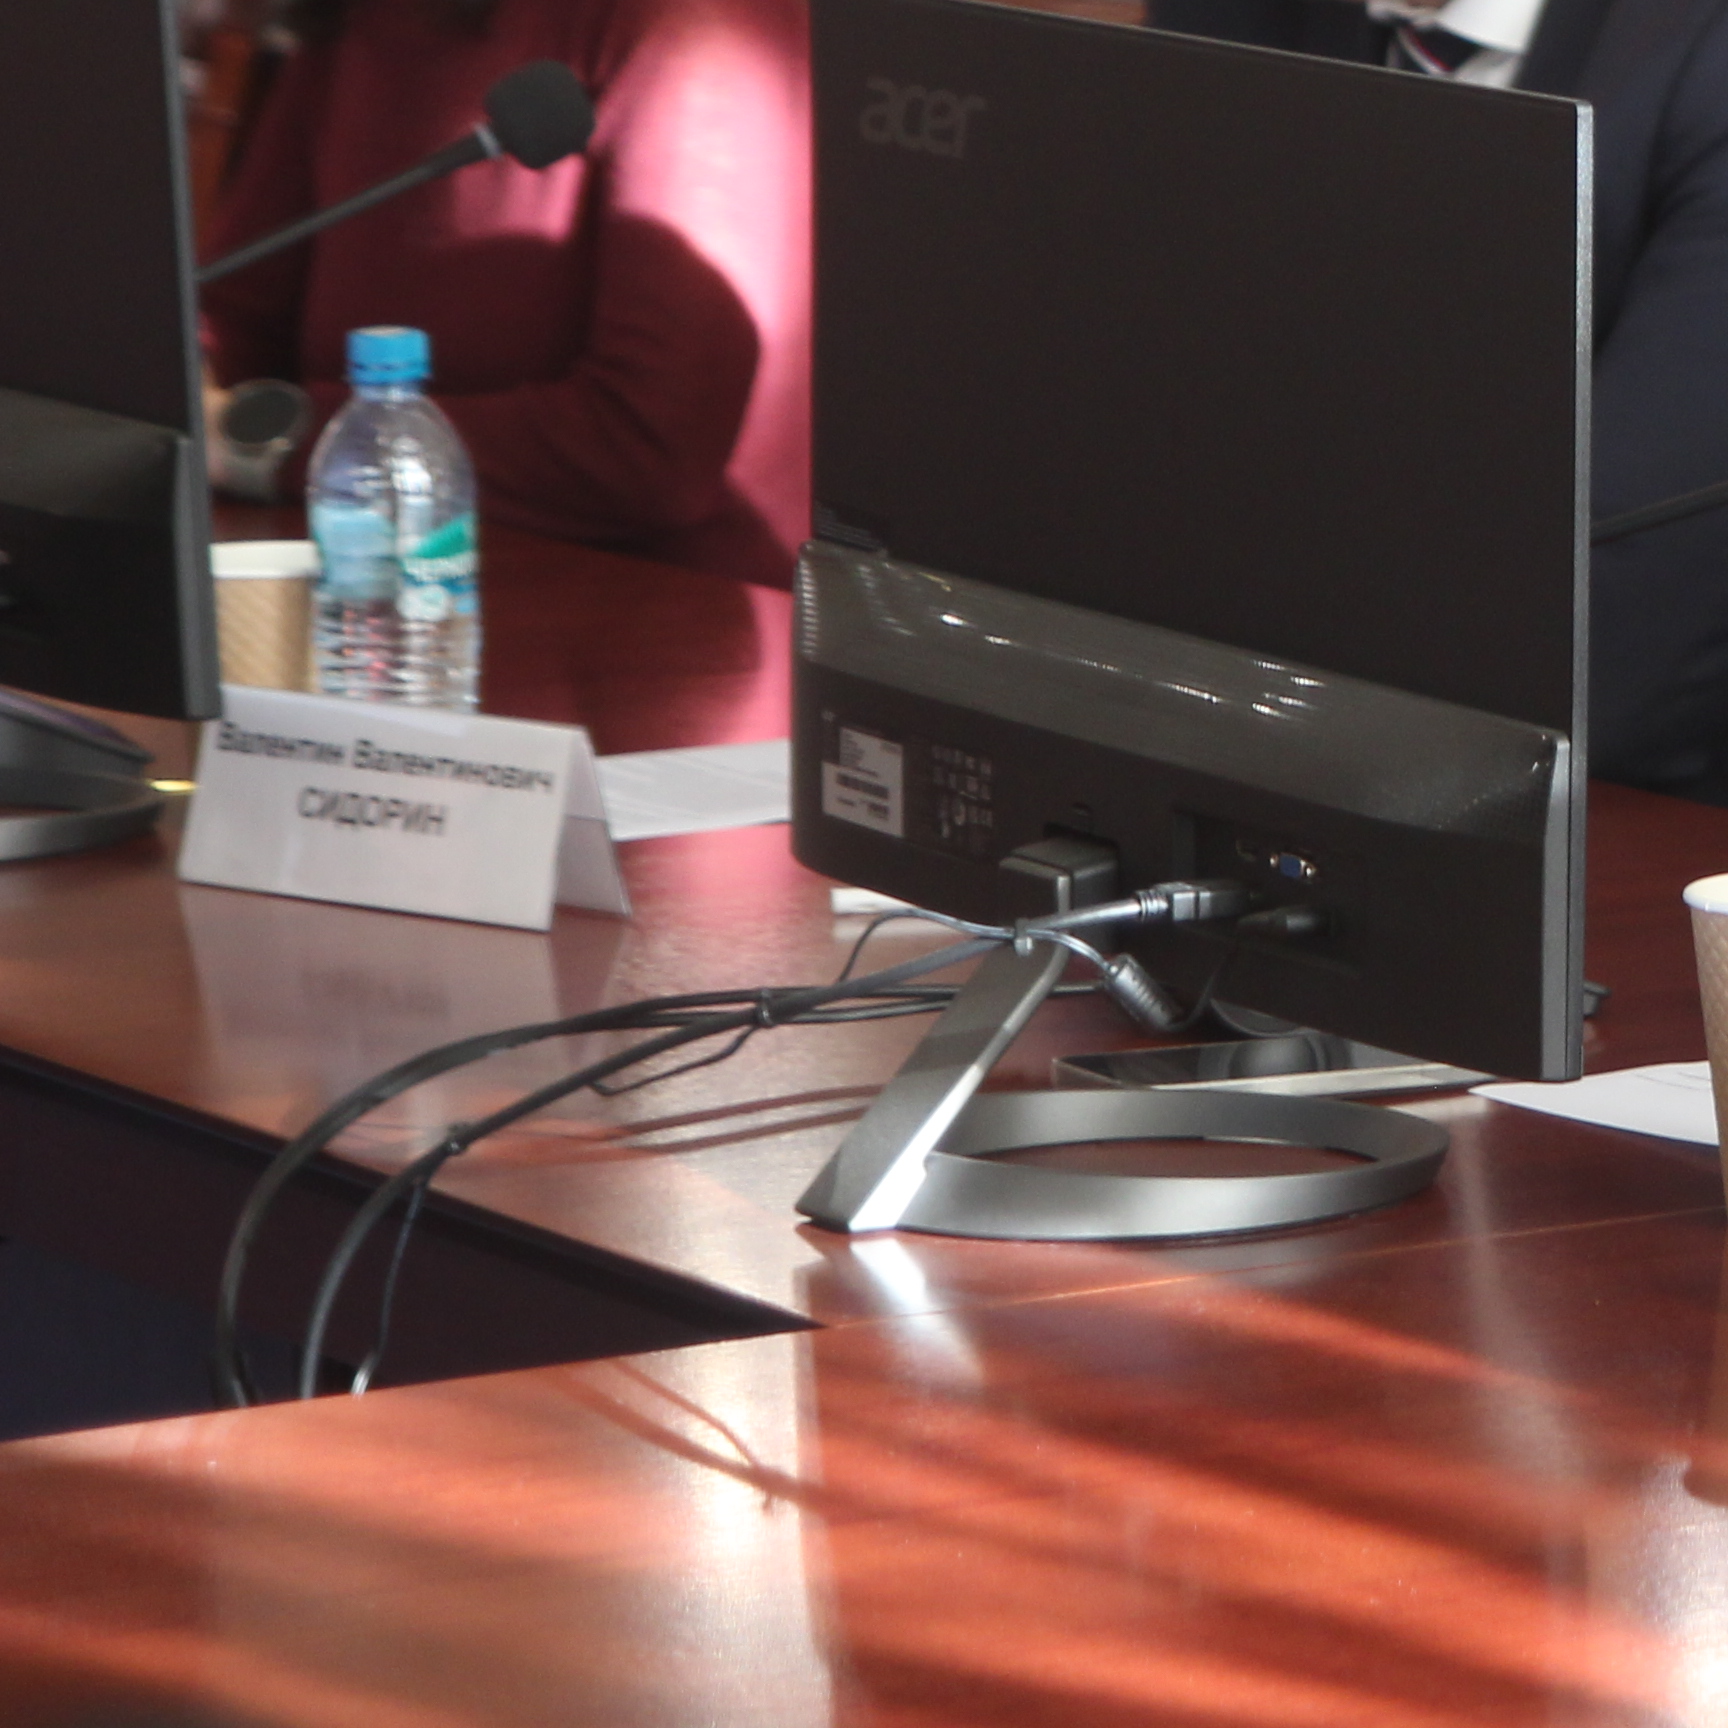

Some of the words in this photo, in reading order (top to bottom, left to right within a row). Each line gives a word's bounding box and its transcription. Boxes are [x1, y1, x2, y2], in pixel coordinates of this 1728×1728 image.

[860, 75, 987, 160] acer
[217, 721, 344, 765] Валентин
[353, 738, 554, 793] Валентинович
[299, 785, 449, 836] СИДОРИН
